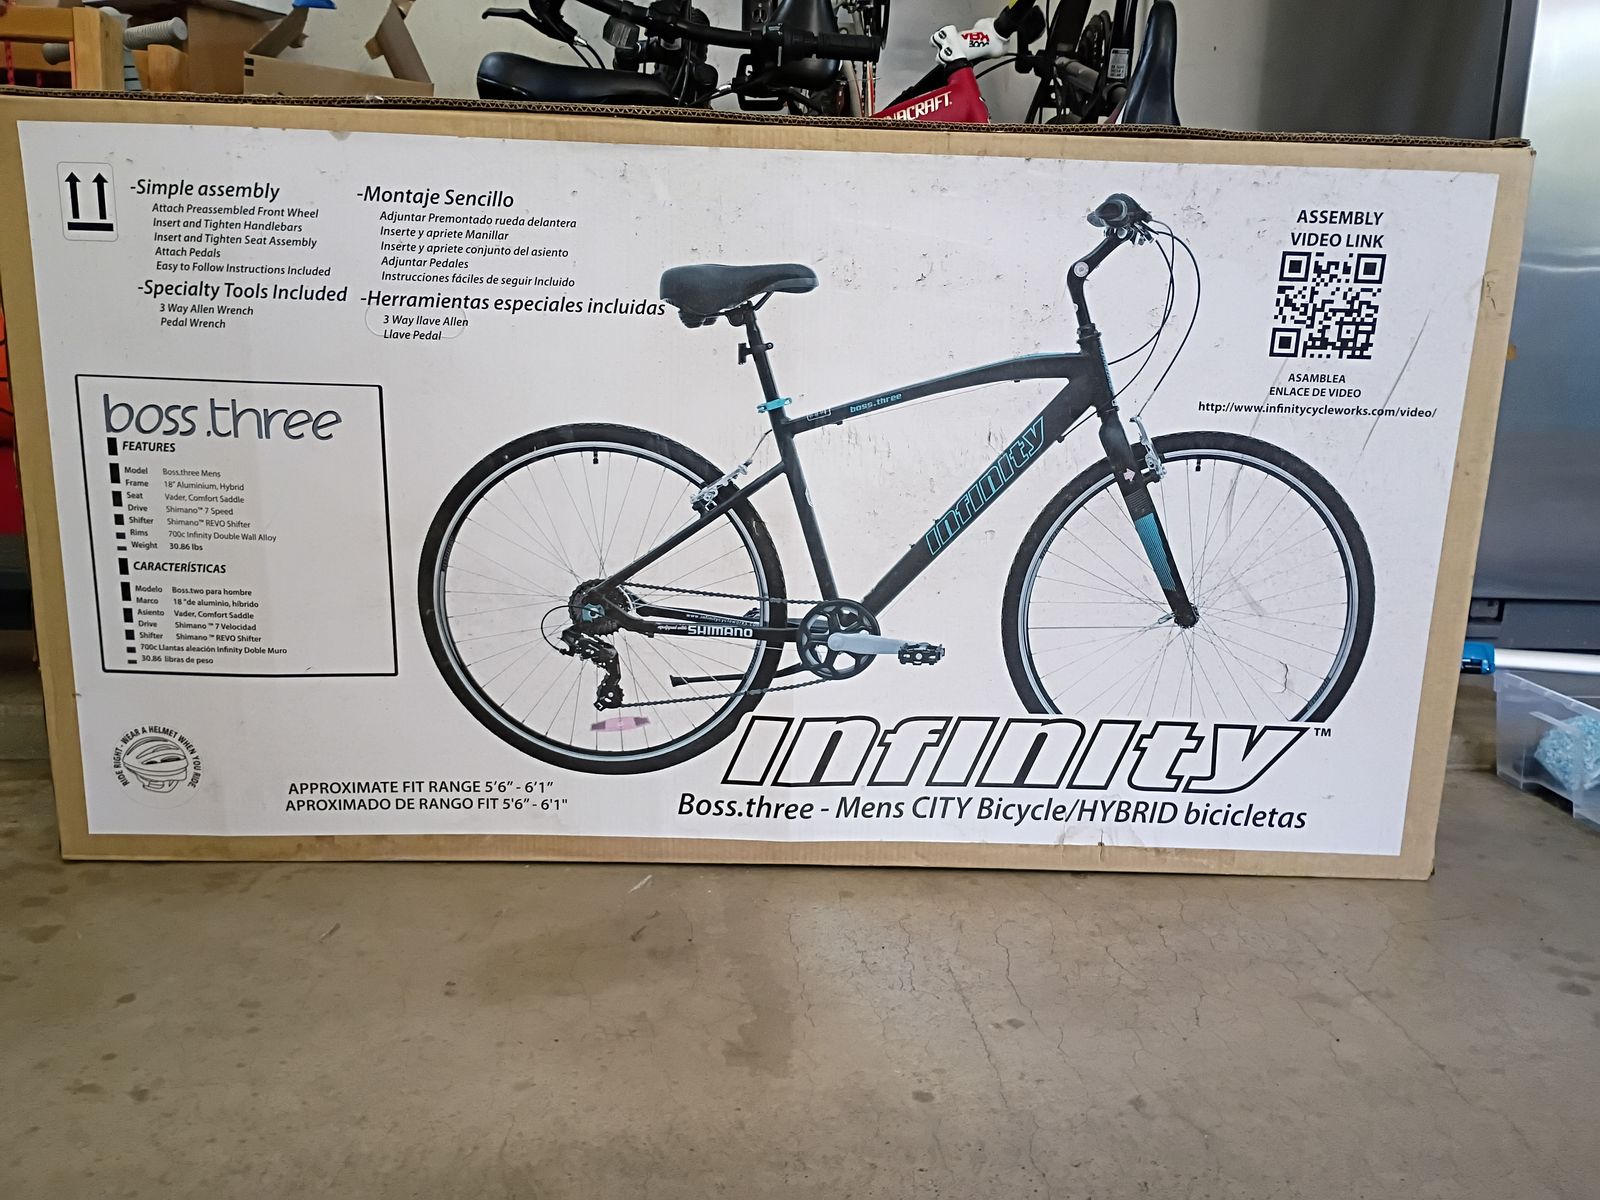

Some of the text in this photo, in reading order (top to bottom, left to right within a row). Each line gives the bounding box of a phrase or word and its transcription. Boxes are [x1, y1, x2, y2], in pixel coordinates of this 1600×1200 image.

[130, 179, 280, 202] -Simple assembly
[357, 186, 514, 208] -Montaje Sencillo
[152, 203, 318, 218] Attach Preassembled Front Wheel
[380, 211, 576, 228] Adjuntar Premontado rueda delantera
[1297, 210, 1384, 225] ASSEMBLY
[153, 218, 302, 232] Insert and Tighten Handlebars
[380, 227, 508, 240] Inserte apriete Manillar
[1291, 232, 1384, 248] VIDEO LINK
[154, 233, 317, 248] Insert and Tighten Seat Assembly
[155, 247, 221, 258] Attach Pedals
[381, 242, 568, 258] Inserte apriete conjunto del asiento
[156, 261, 331, 276] Easy to Follow Instructions Included
[381, 257, 469, 269] Adjuntar Pedales
[381, 272, 575, 288] Instrucciones fáciles de seguir Incluido
[137, 280, 347, 302] -Specialty Tools Included
[167, 304, 253, 315] Way Allen Wrench
[361, 290, 665, 316] -Herramientas especiales incluidas
[160, 318, 225, 329] Pedal Wrench
[392, 315, 414, 327] Way
[443, 317, 468, 327] Allen
[383, 330, 441, 341] Llave Pedal
[1288, 374, 1346, 383] ASAMBLEA
[1269, 387, 1361, 398] ENLACE DE VIDEO
[1198, 401, 1436, 418] http://www.infinitycycleworks.com/video/
[104, 394, 342, 440] boss.three
[122, 441, 175, 452] FEATURES
[124, 466, 221, 478] Model Boss.three Mens
[125, 479, 244, 492] Frame Hybrid
[127, 491, 244, 504] Seat Comfort Saddle
[128, 504, 233, 517] Drive Speed
[129, 516, 250, 528] Shifter REVO Shifter
[130, 529, 277, 543] Rims 700c Infinity Double Wall Alloy
[131, 540, 203, 551] Weight 30.86 lbs
[133, 561, 226, 574] CARACTERÍSTICAS
[135, 585, 163, 593] Modelo
[206, 588, 223, 597] para
[224, 587, 252, 596] hombre
[136, 597, 158, 605] Marco
[199, 610, 227, 619] Comfort
[229, 611, 254, 619] Saddle
[138, 620, 157, 628] Drive
[221, 623, 256, 631] Velocidad
[688, 626, 753, 637] SHIMANO
[139, 632, 163, 640] Shifter
[216, 634, 236, 642] REVO
[238, 635, 261, 643] Shifter
[141, 643, 157, 651] 700c
[159, 644, 183, 652] Llantas
[217, 645, 242, 655] Infinity
[244, 646, 266, 654] Doble
[165, 655, 184, 663] libras
[120, 729, 140, 744] WEAR
[149, 726, 178, 738] HELMET
[178, 735, 197, 755] WHEN
[113, 747, 122, 768] RIGHT
[192, 755, 201, 770] YOU
[115, 770, 130, 786] RIDE
[187, 772, 201, 788] RIDE
[289, 781, 481, 795] APPROXIMATE FIT RANGE
[286, 799, 391, 811] APROXIMADO
[395, 799, 415, 810] DE
[419, 798, 473, 810] RANGO
[478, 798, 499, 809] FIT
[678, 793, 1307, 829] Boss.three Mens CITY Bicycle/HYBRID bicicletas
